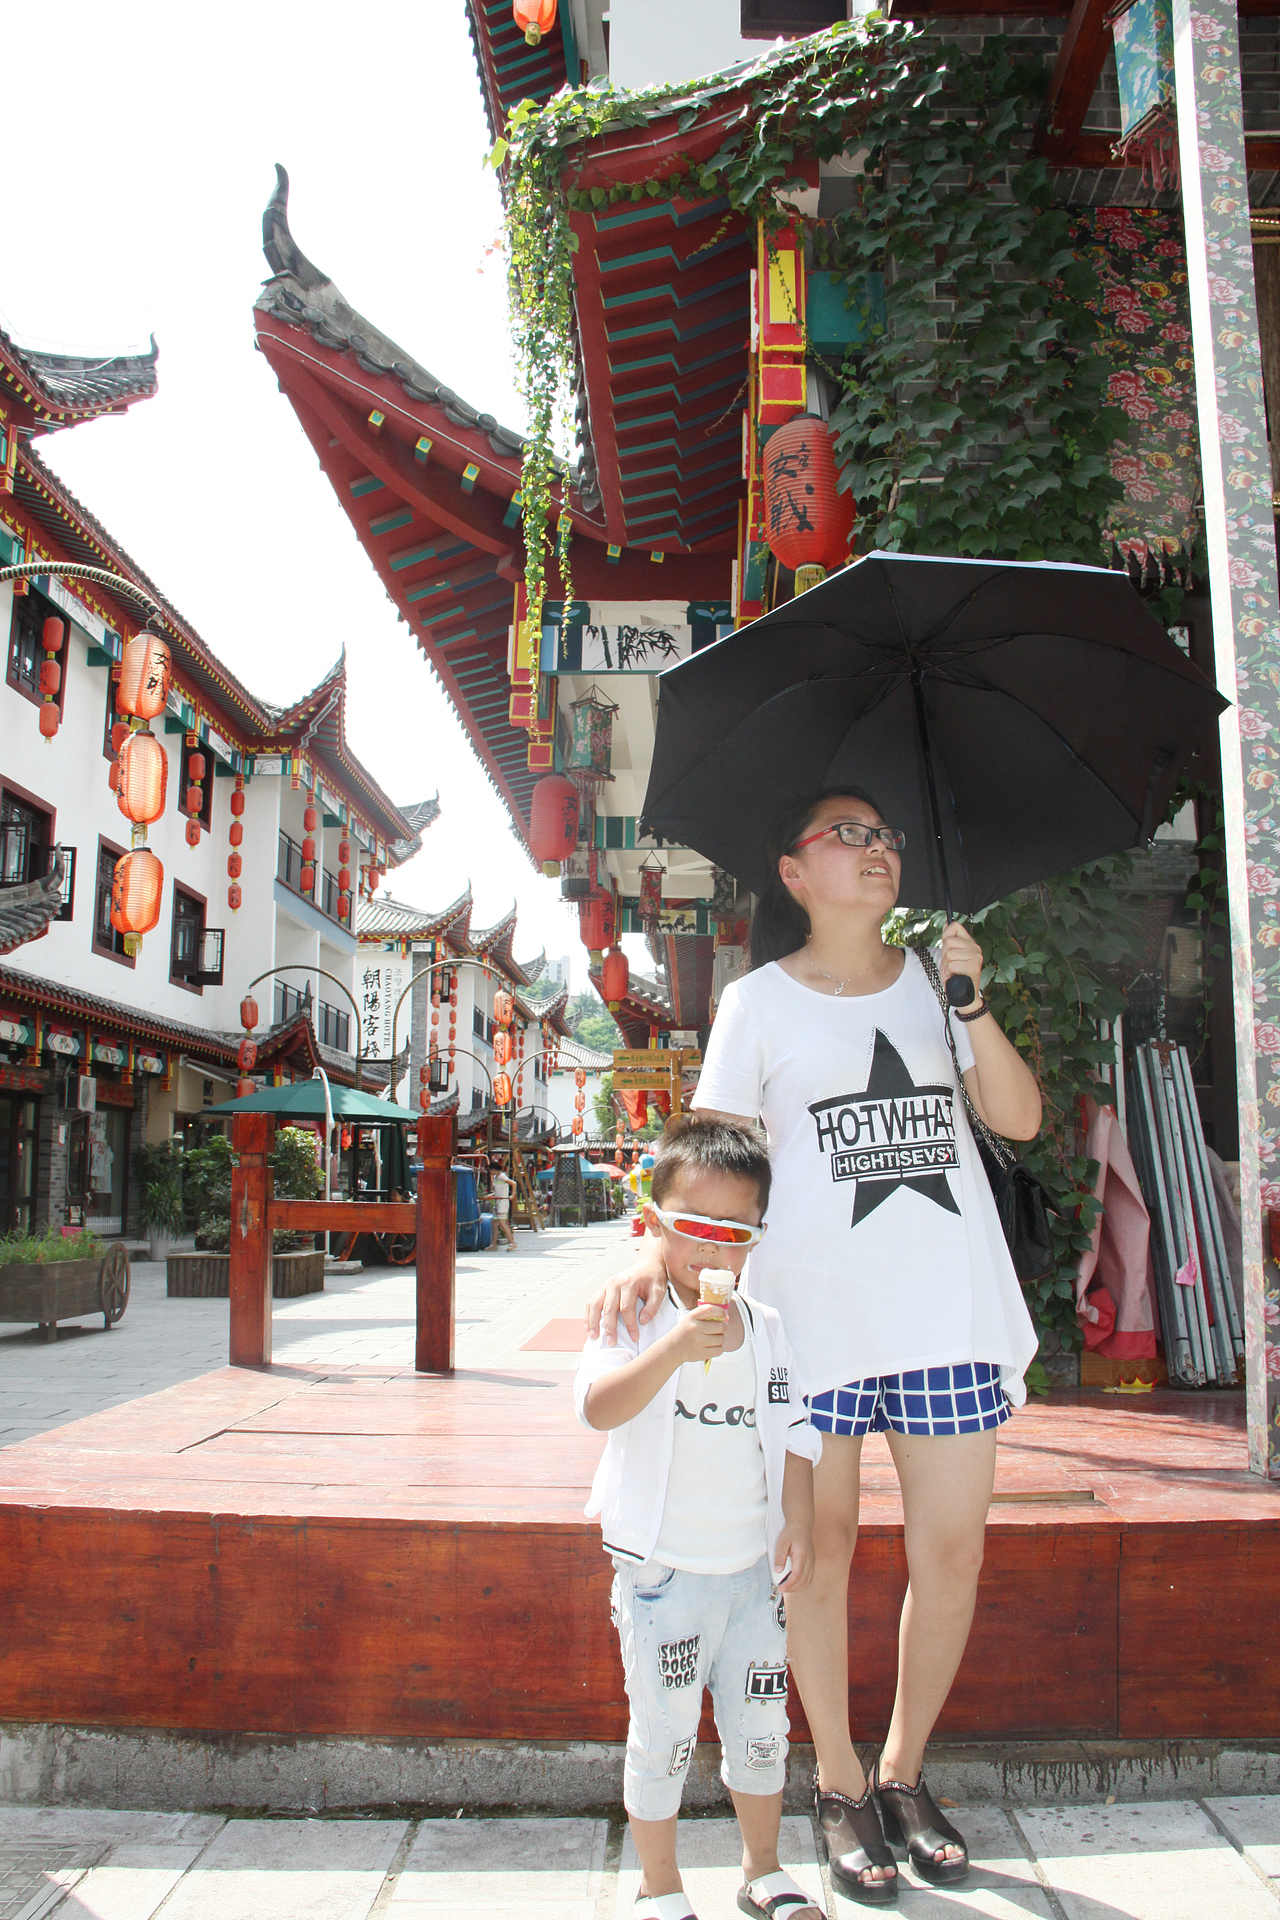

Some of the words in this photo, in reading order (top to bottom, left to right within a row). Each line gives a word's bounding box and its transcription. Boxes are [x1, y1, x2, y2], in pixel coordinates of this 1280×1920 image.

[384, 968, 392, 1017] CHAOYANG
[383, 1019, 391, 1048] HOTEL
[661, 1634, 699, 1659] SNOOP
[661, 1652, 698, 1674] DOGGY
